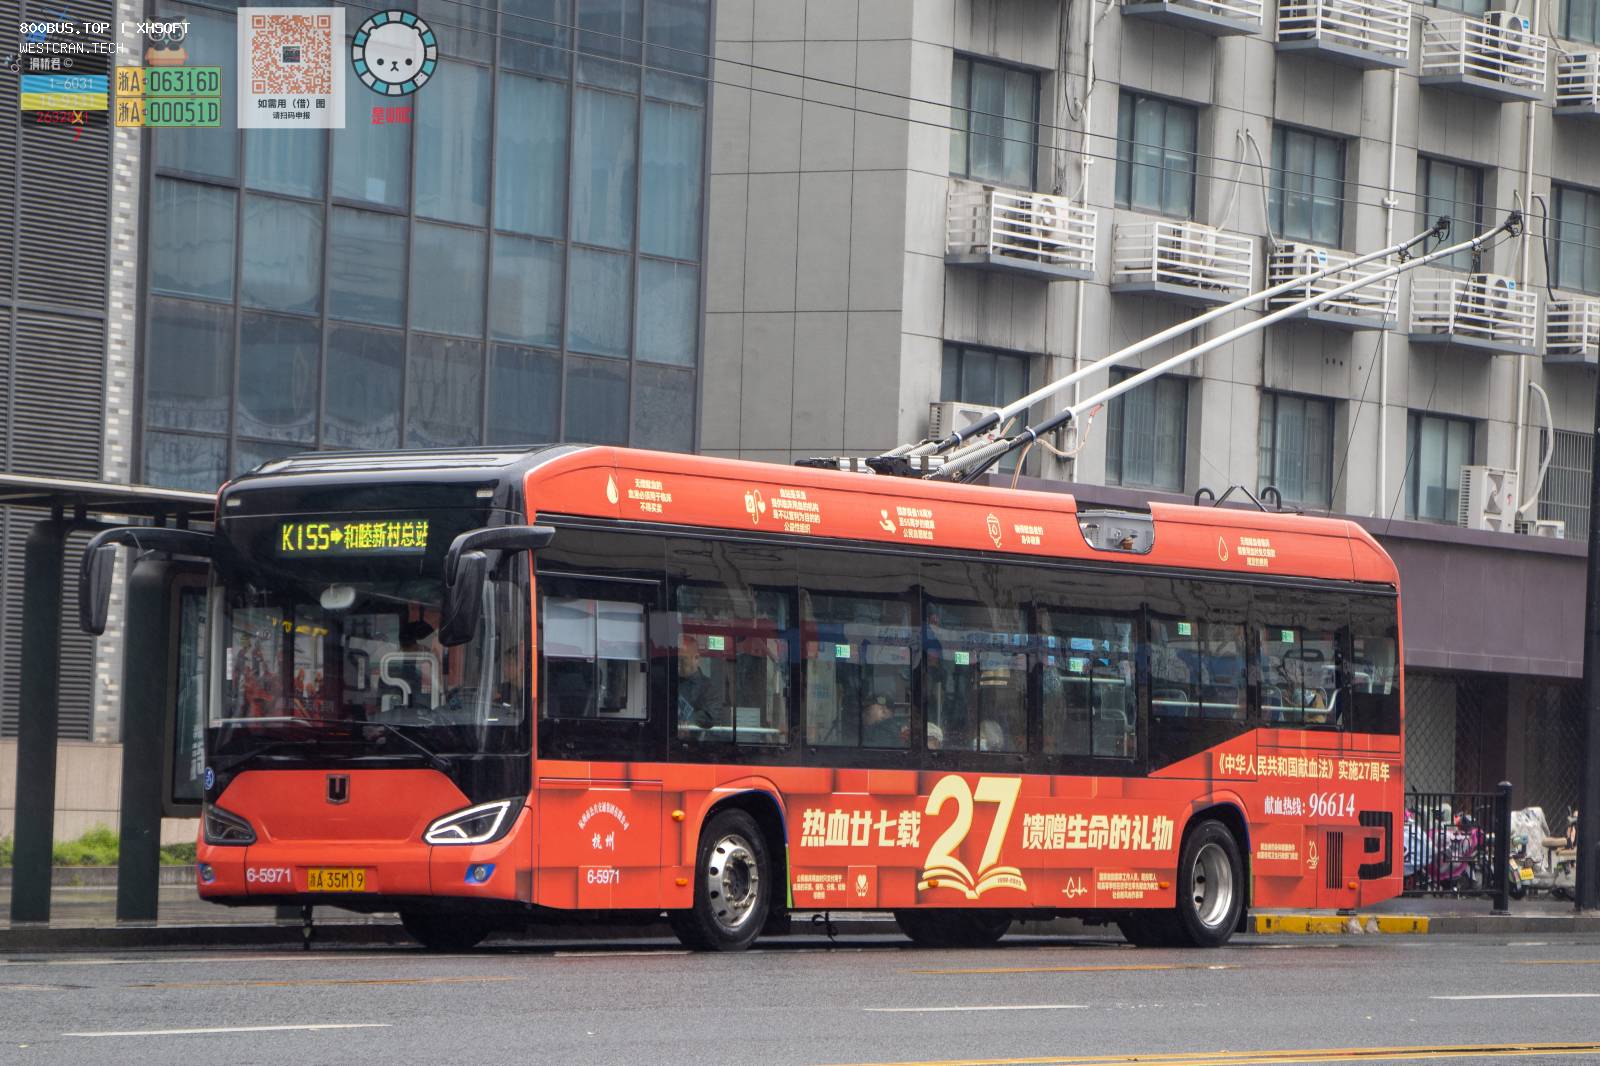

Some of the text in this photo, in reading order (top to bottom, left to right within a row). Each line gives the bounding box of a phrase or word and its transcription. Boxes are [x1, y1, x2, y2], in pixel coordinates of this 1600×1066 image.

[1308, 791, 1355, 818] 96614
[800, 808, 922, 849] 热血廿七载
[924, 774, 1023, 878] 27
[1022, 812, 1174, 852] 馈赠生命的礼物
[246, 867, 292, 883] 6-5971
[586, 869, 620, 885] 6-5971
